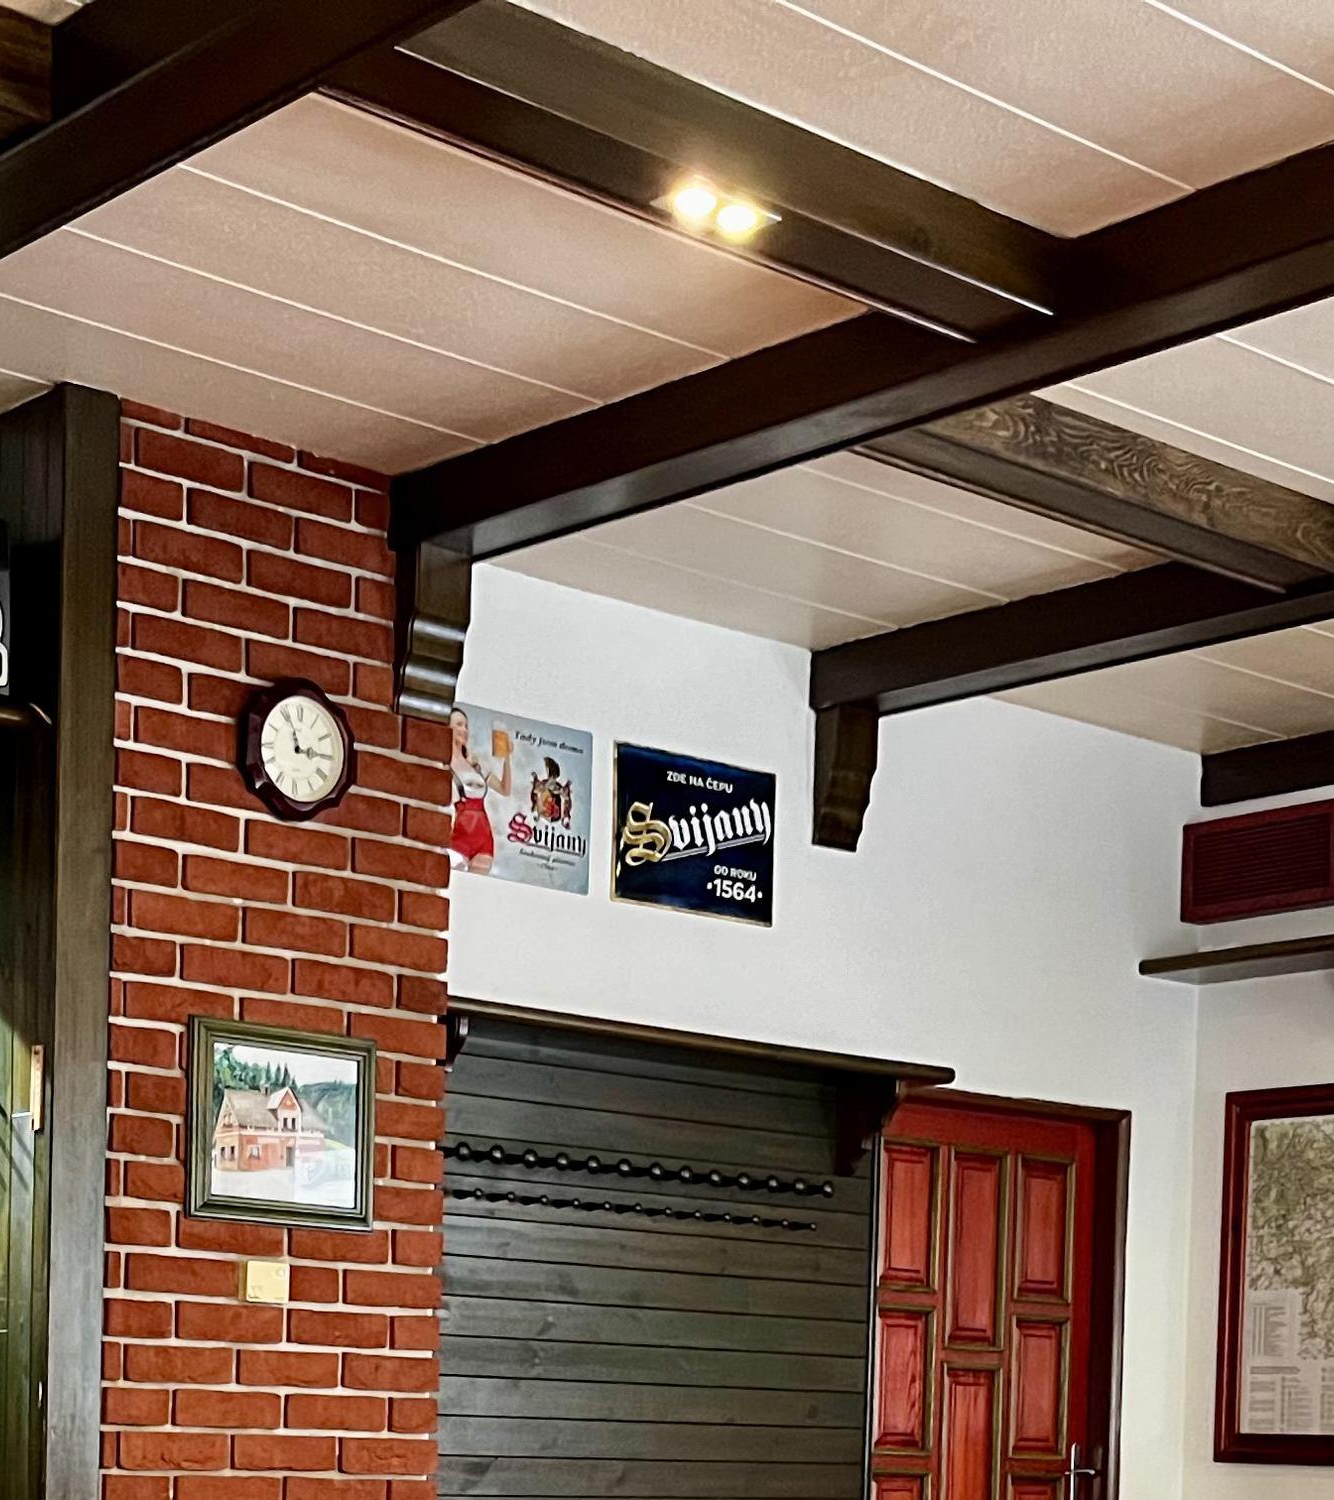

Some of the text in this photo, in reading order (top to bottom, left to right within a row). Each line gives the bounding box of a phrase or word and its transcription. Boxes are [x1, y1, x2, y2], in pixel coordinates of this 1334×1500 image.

[667, 770, 733, 794] ZDE NA ČEPU
[507, 812, 587, 858] Svijany
[620, 798, 772, 866] Svijany
[714, 864, 757, 881] OD ROKU
